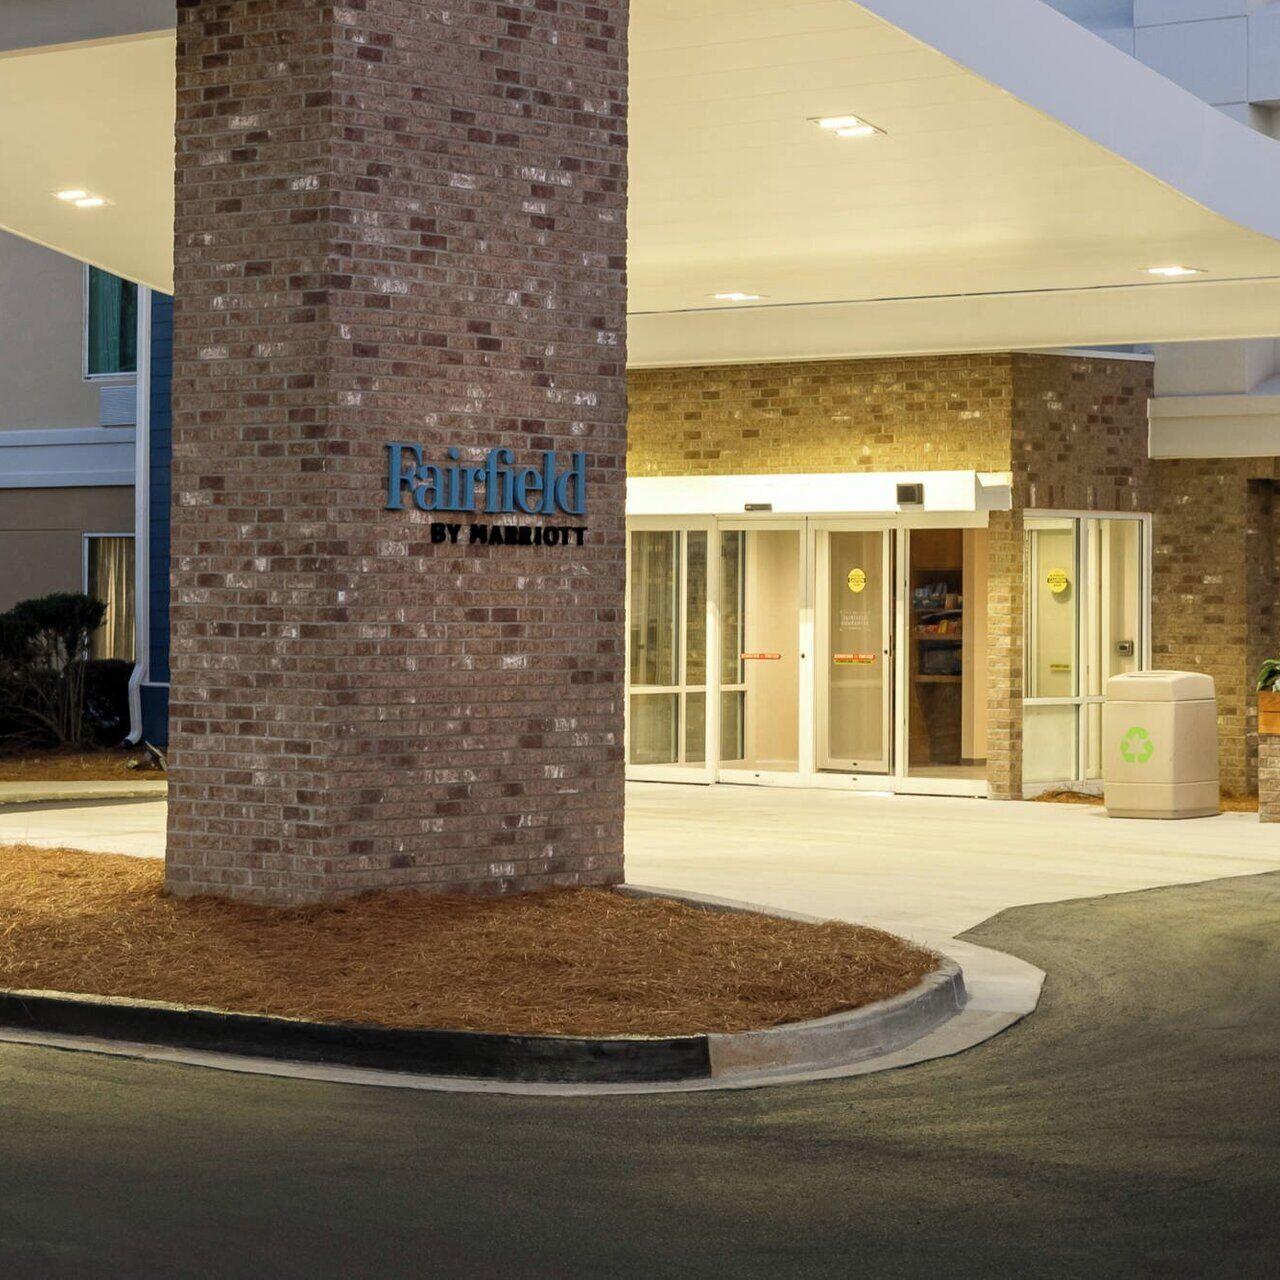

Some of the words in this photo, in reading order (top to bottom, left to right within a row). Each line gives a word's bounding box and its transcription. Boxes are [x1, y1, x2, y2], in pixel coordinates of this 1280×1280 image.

[384, 440, 588, 516] Fairfield
[430, 521, 462, 545] BY
[469, 523, 589, 547] MARRIOTT
